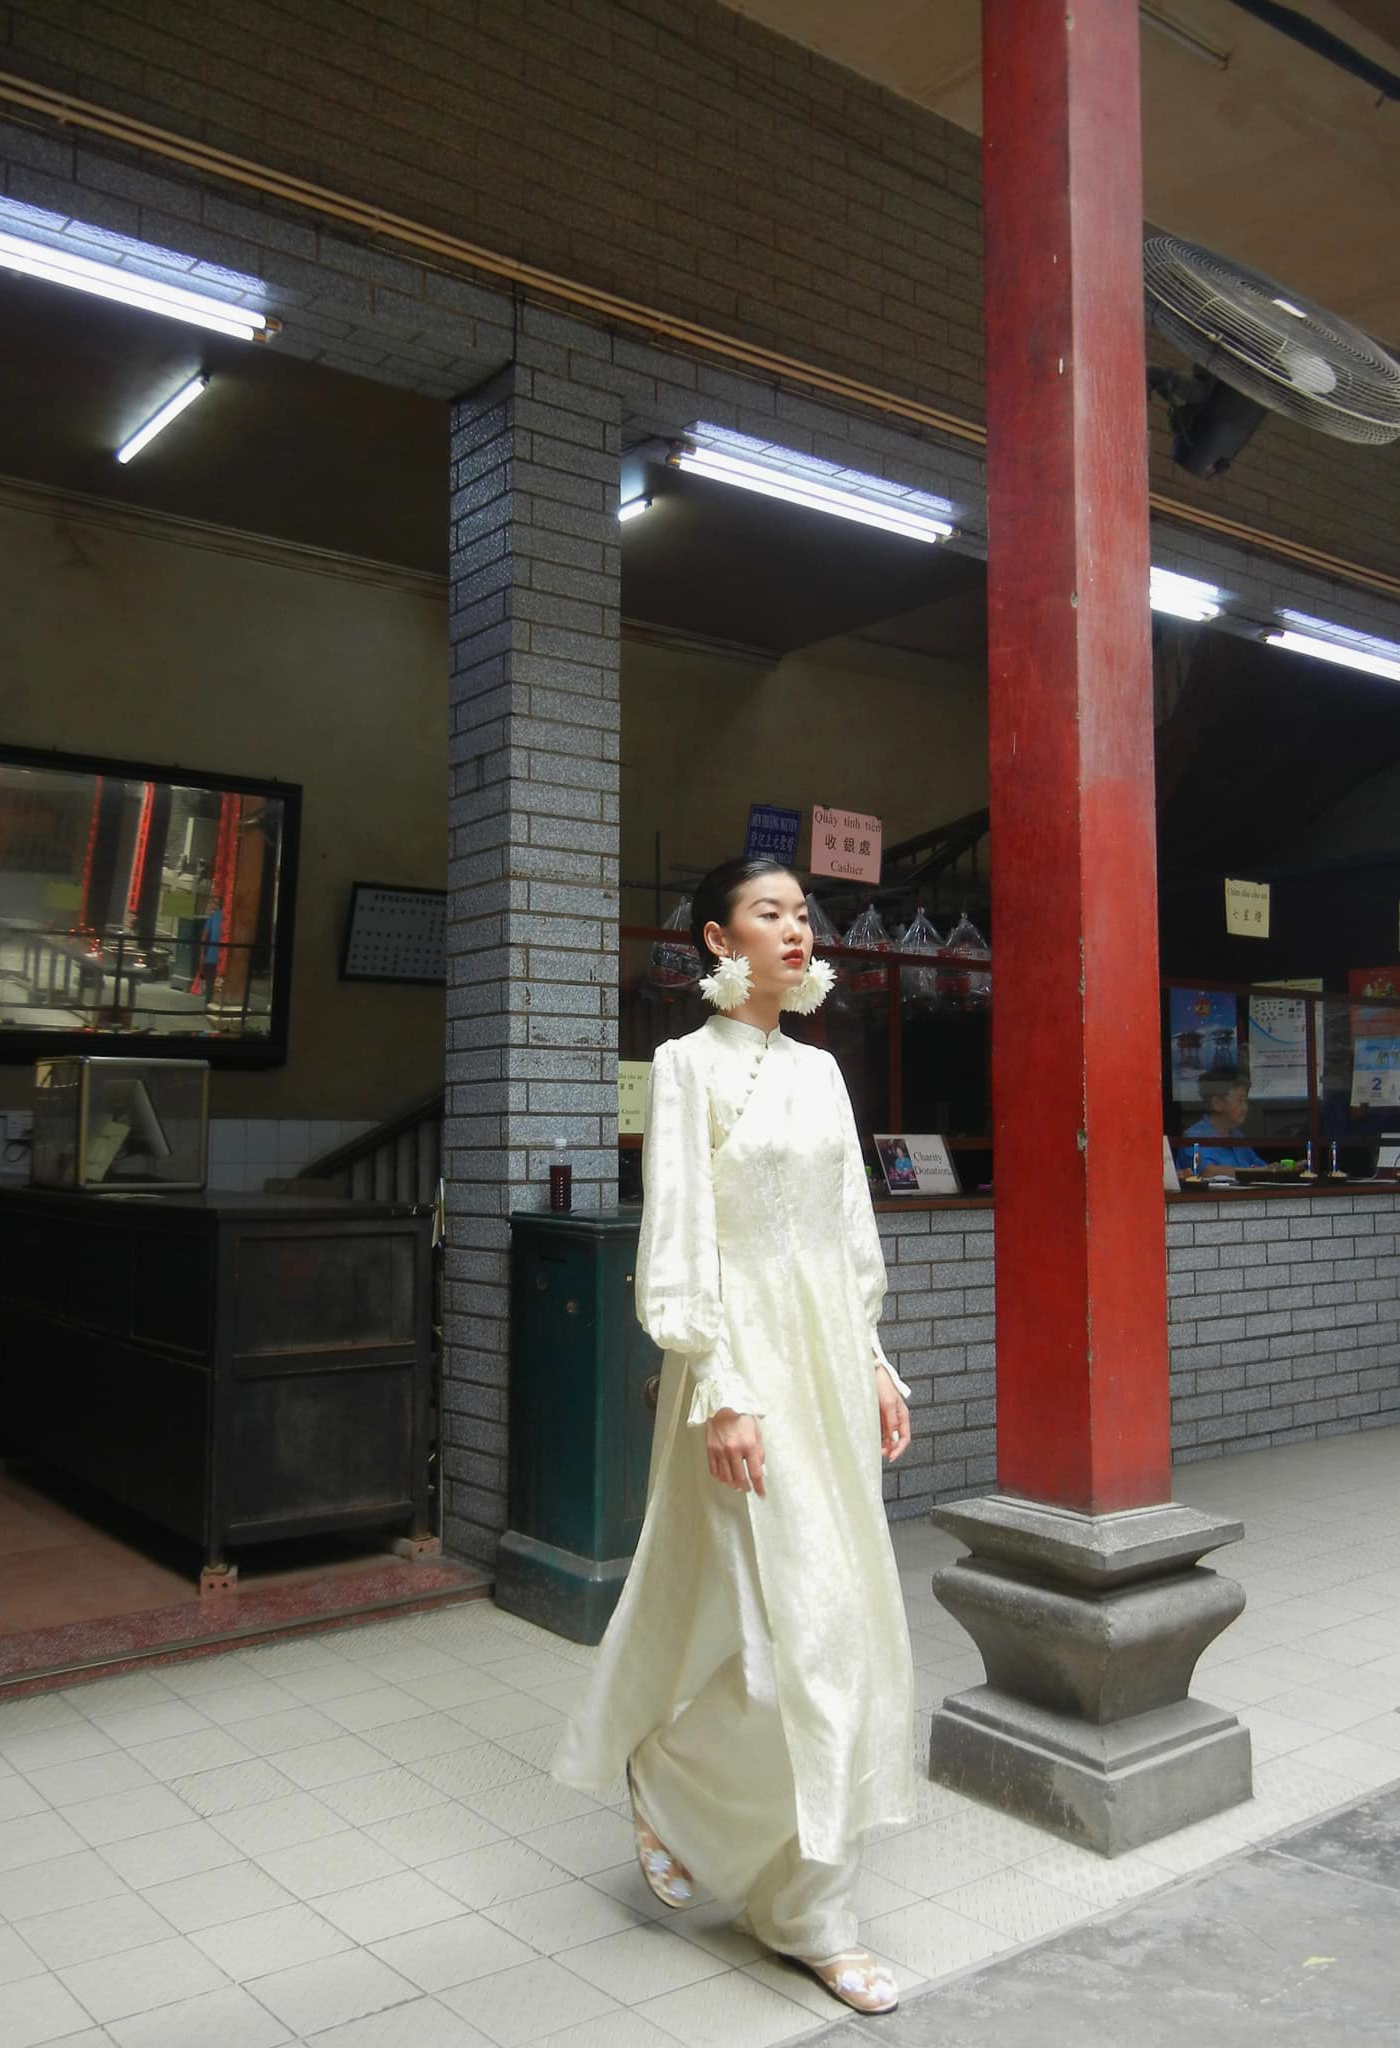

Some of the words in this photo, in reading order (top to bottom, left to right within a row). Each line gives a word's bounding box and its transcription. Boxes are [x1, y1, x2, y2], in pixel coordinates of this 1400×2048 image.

[831, 860, 864, 875] Cashier
[1371, 1077, 1382, 1091] 2
[913, 1151, 942, 1164] Charity
